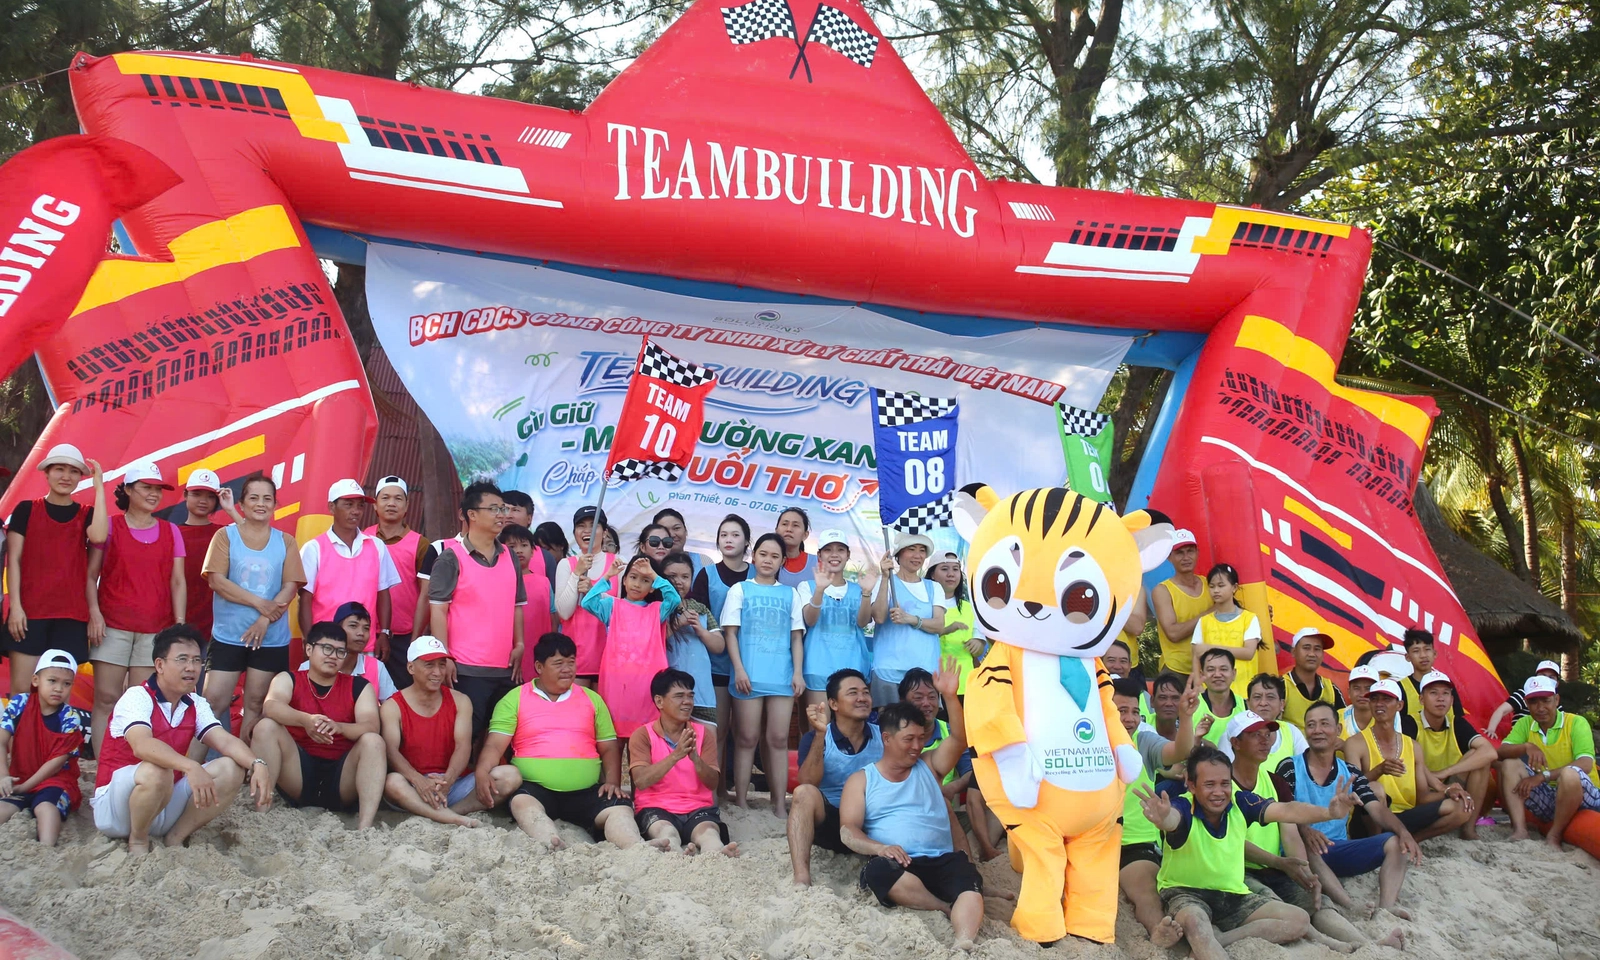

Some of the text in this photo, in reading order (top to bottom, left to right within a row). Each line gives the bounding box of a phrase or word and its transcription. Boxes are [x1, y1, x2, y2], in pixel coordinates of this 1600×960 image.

[607, 122, 978, 239] TEAMBUILDING
[409, 310, 463, 347] BCH
[461, 306, 530, 335] CĐCS
[529, 312, 604, 332] CÙNG
[601, 316, 675, 337] CÔNG
[673, 323, 707, 341] TY
[704, 328, 775, 350] TNHH
[768, 339, 817, 356] XỬ
[804, 345, 848, 360] LÝ
[838, 347, 904, 369] CHẤT
[899, 355, 960, 380] THẢI
[953, 364, 1011, 390] VIỆT
[1001, 374, 1066, 406] NAM
[550, 401, 596, 425] Giữ
[647, 382, 692, 423] TEAM
[639, 413, 677, 459] 10
[699, 418, 805, 455] ƯỜNG
[804, 436, 877, 469] XAN
[897, 429, 948, 452] TEAM
[1080, 438, 1101, 461] TE
[687, 447, 850, 501] UỔI THƠ
[904, 456, 946, 496] 08
[1089, 461, 1111, 495] 0
[724, 497, 740, 507] 06
[748, 500, 808, 514] 07.06.2
[1044, 746, 1111, 757] VIETNAM WAS
